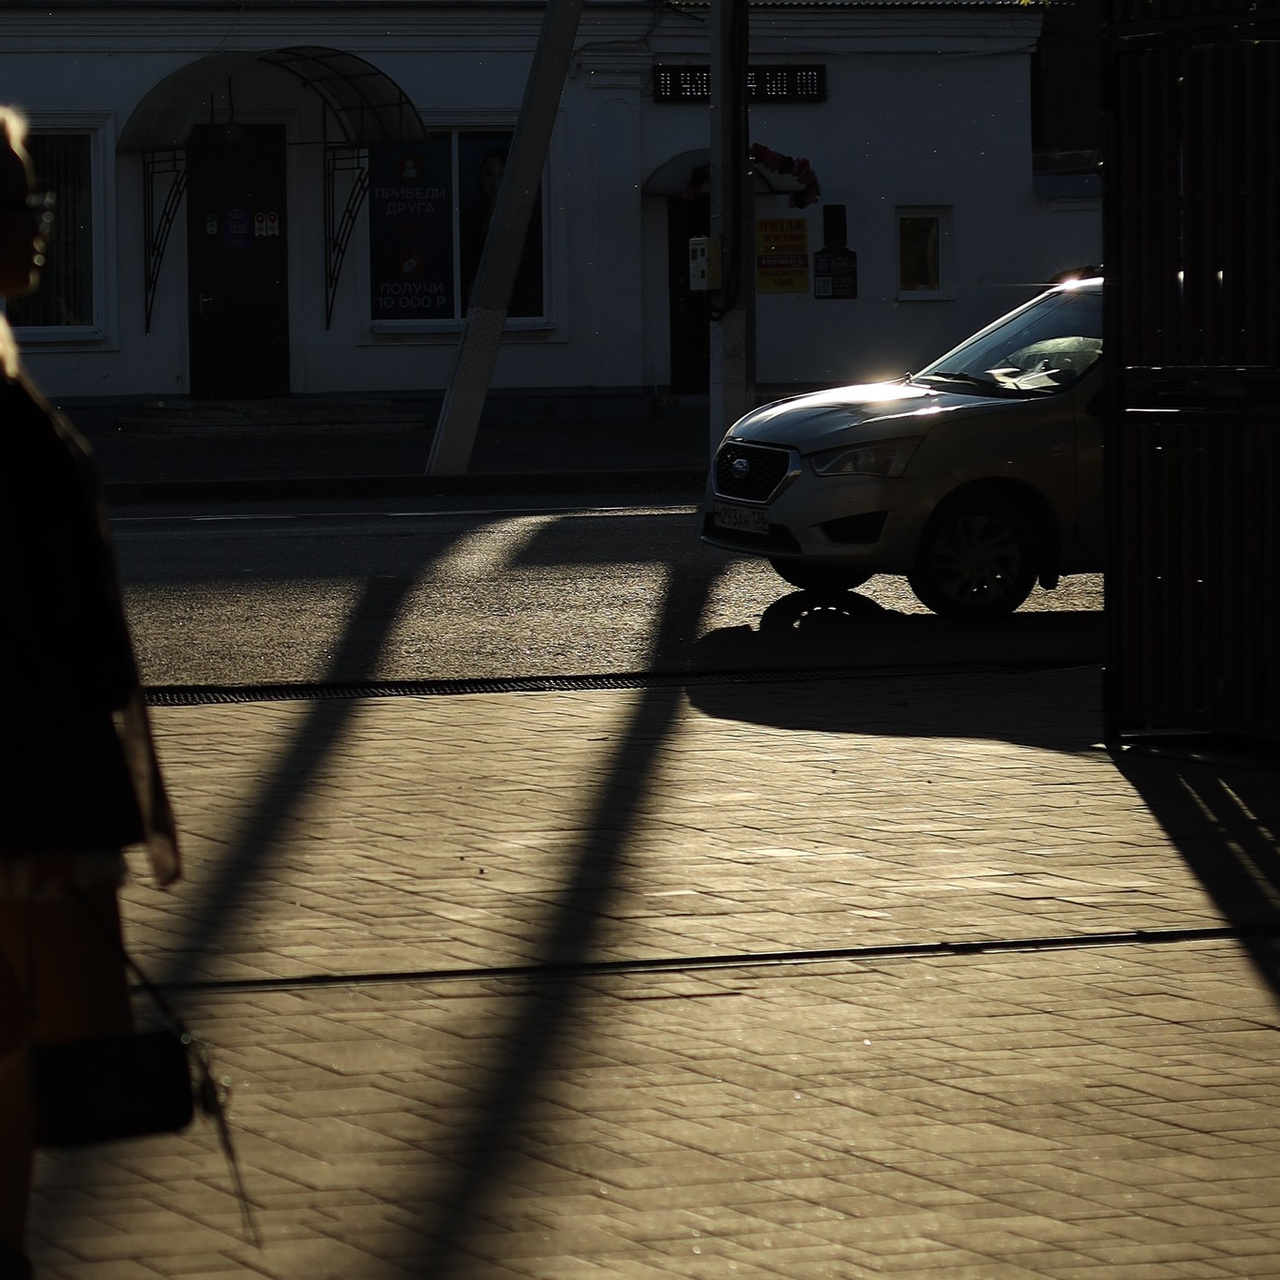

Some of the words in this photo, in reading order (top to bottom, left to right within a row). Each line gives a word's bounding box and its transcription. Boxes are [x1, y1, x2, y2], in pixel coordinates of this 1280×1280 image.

[374, 187, 446, 200] ПРИВЕДИ
[386, 202, 436, 216] ДРУГА
[760, 220, 804, 232] МАССАЖ
[380, 282, 444, 295] ПОЛУЧИ
[378, 296, 394, 309] 10
[399, 296, 432, 309] 000
